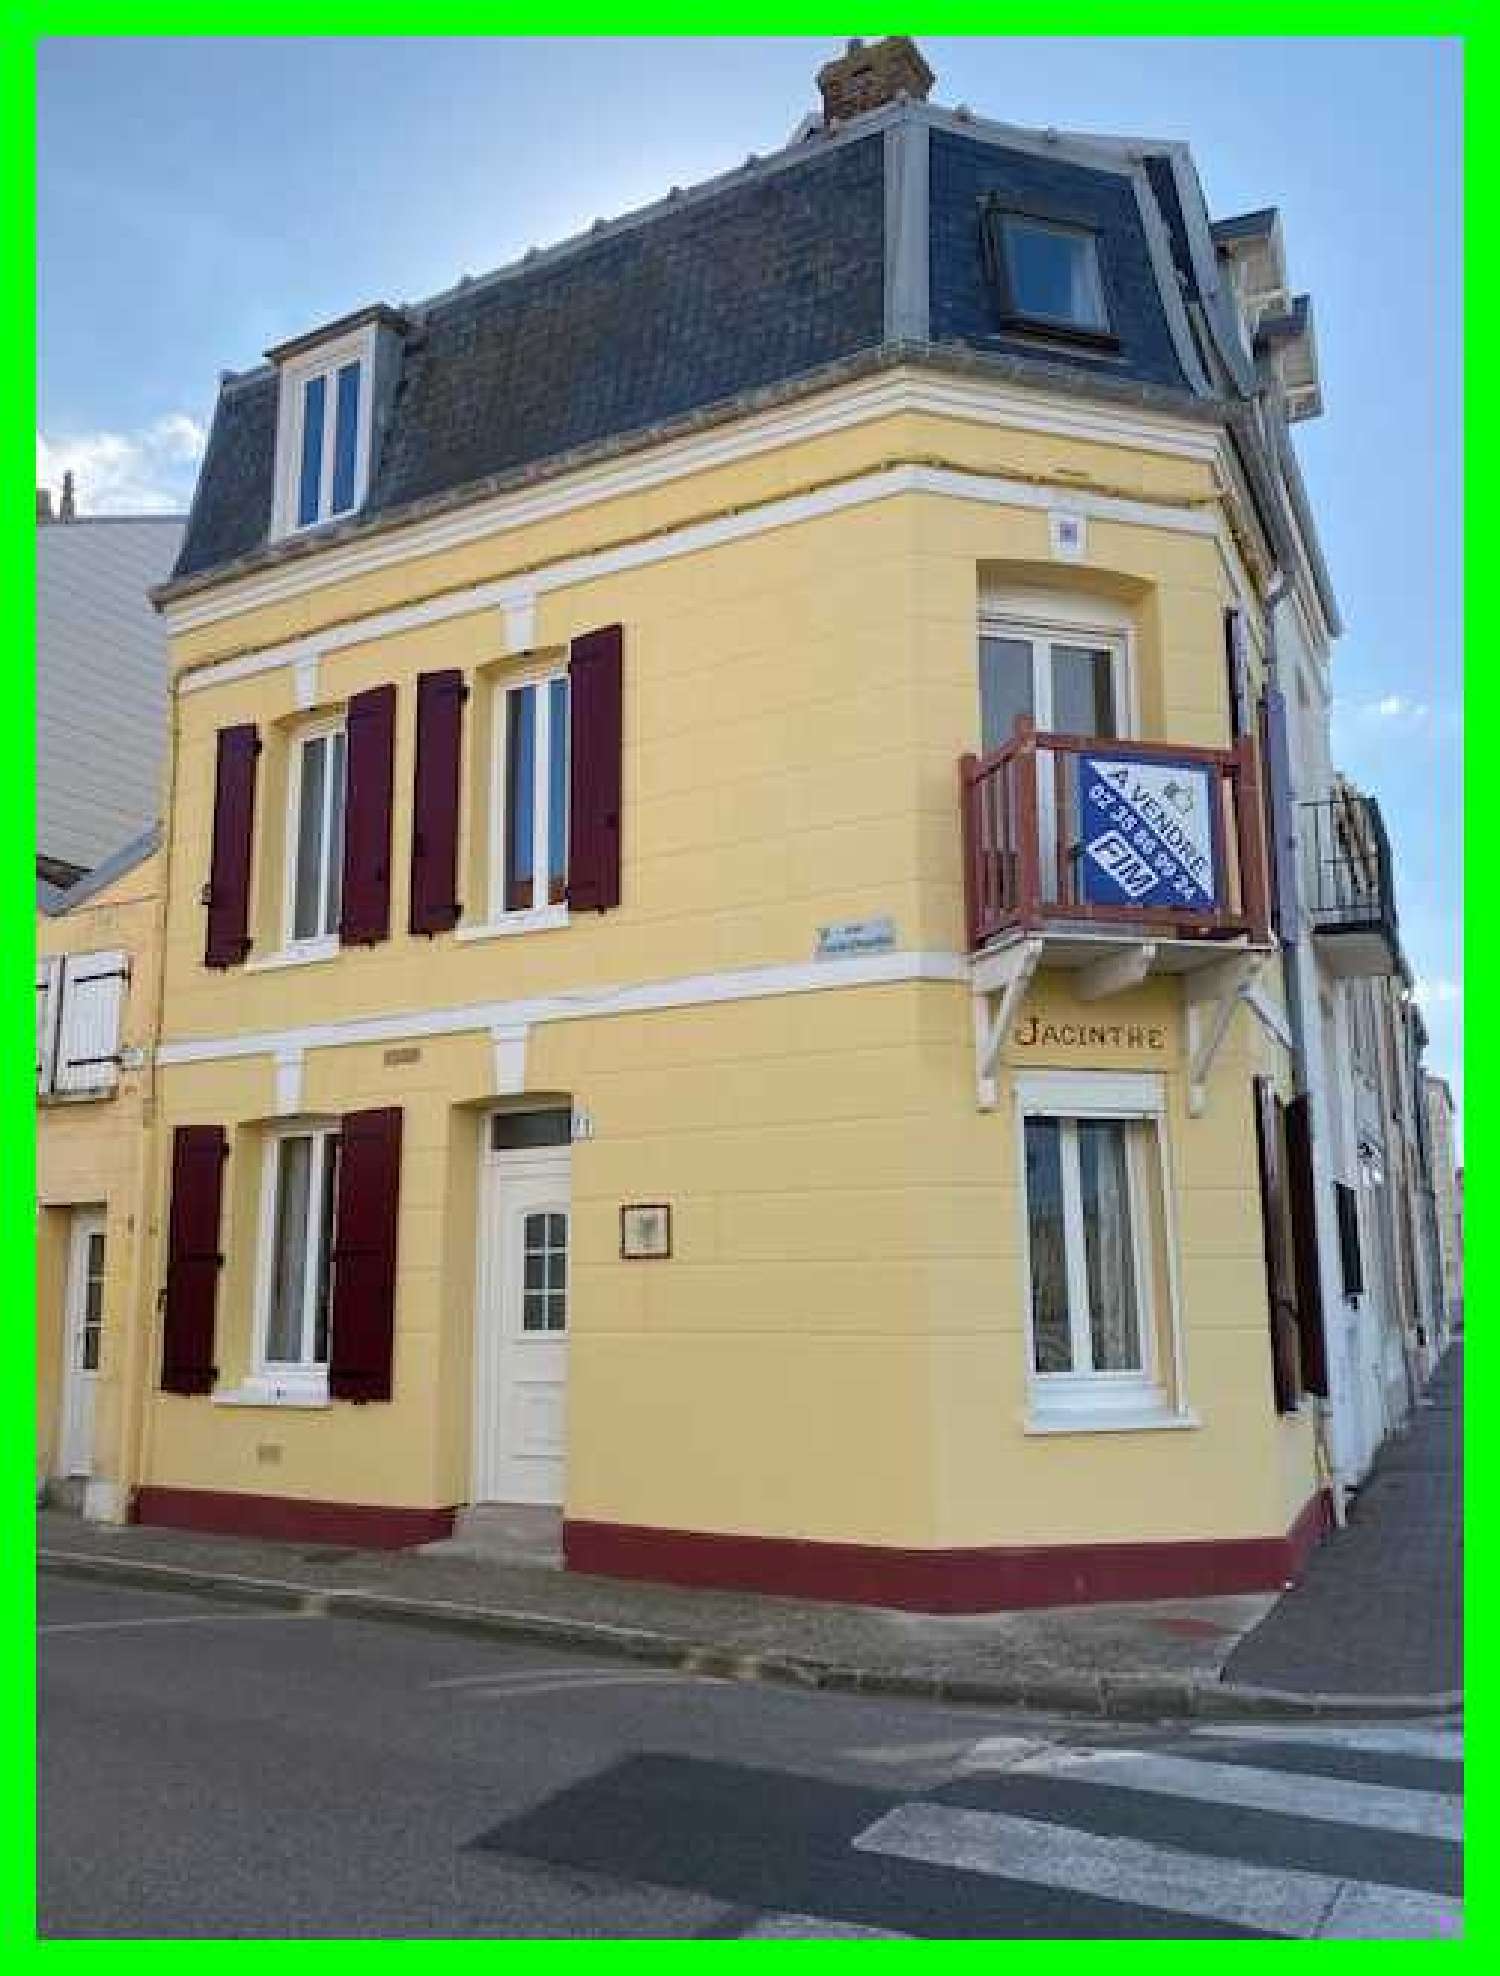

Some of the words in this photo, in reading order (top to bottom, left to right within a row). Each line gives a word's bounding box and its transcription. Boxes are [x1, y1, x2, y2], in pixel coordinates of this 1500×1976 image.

[1094, 836, 1155, 892] FIM
[1107, 769, 1129, 789] A
[1132, 784, 1208, 878] VENDRE
